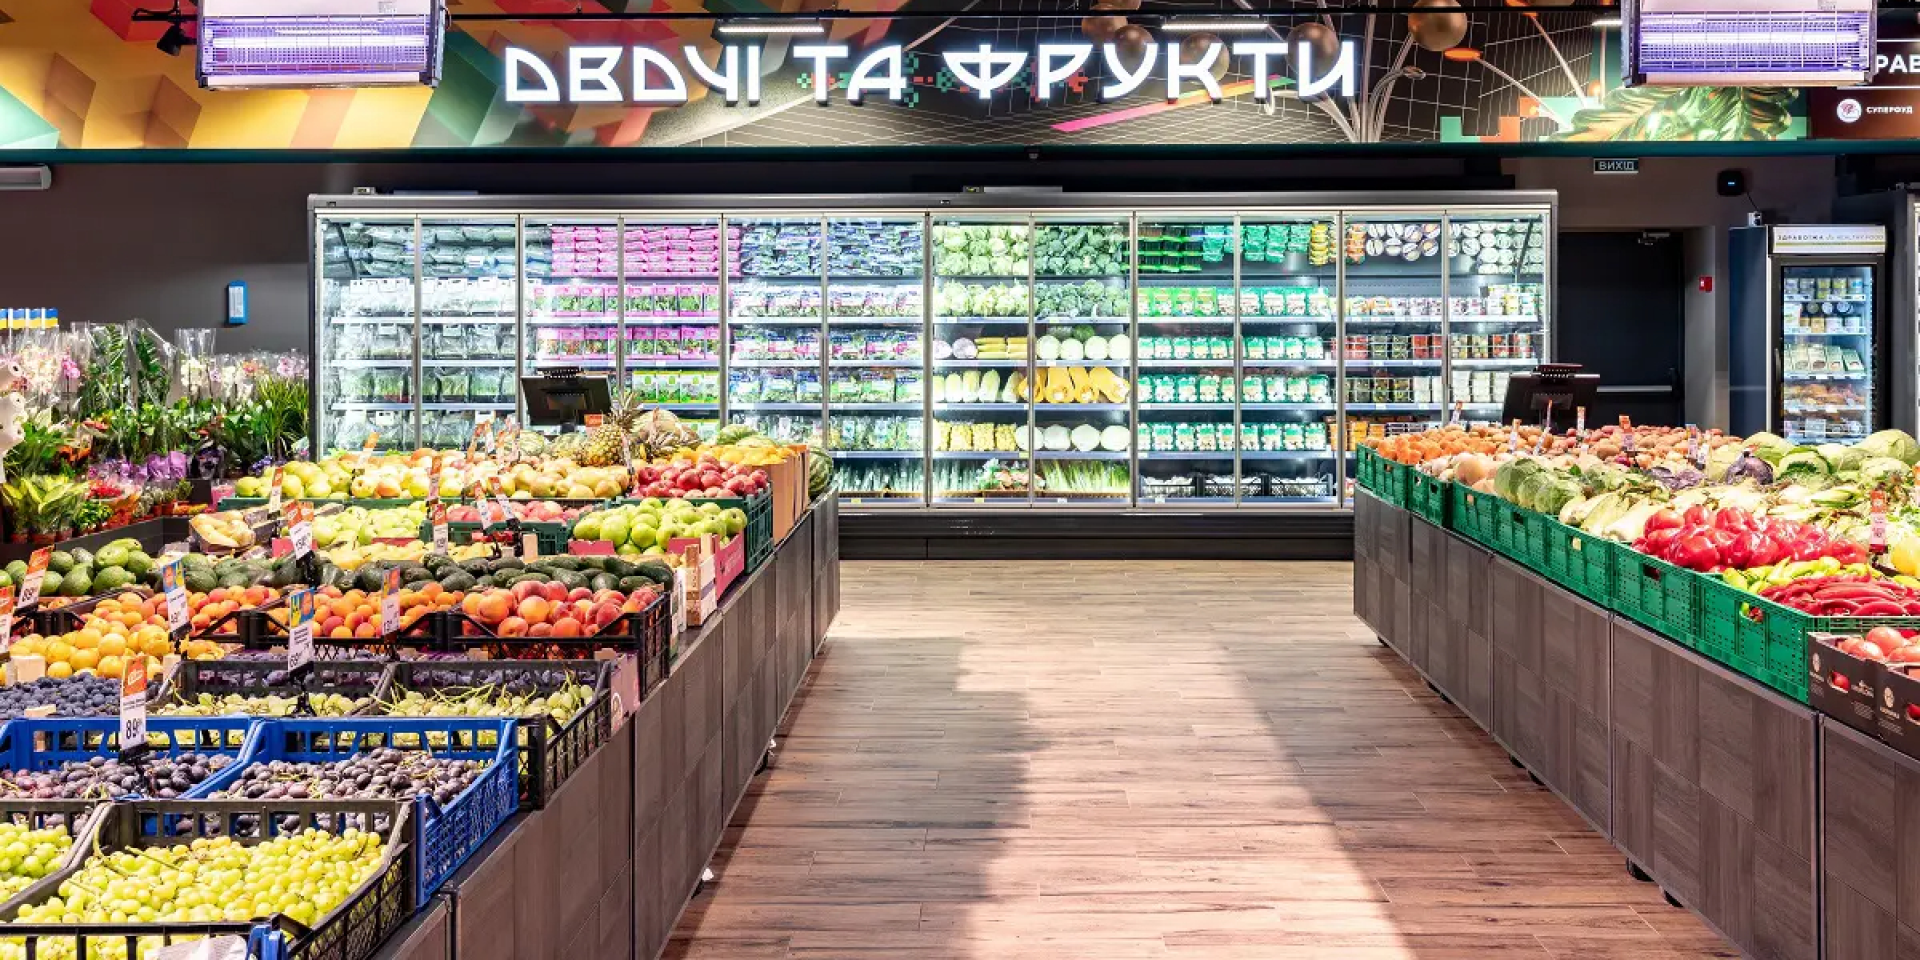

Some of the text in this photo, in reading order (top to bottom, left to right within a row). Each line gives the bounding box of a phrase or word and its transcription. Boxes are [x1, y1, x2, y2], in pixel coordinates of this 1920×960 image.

[793, 44, 907, 101] ТА
[942, 42, 1358, 101] ФРУКТИ
[1599, 161, 1635, 171] ВИХІД
